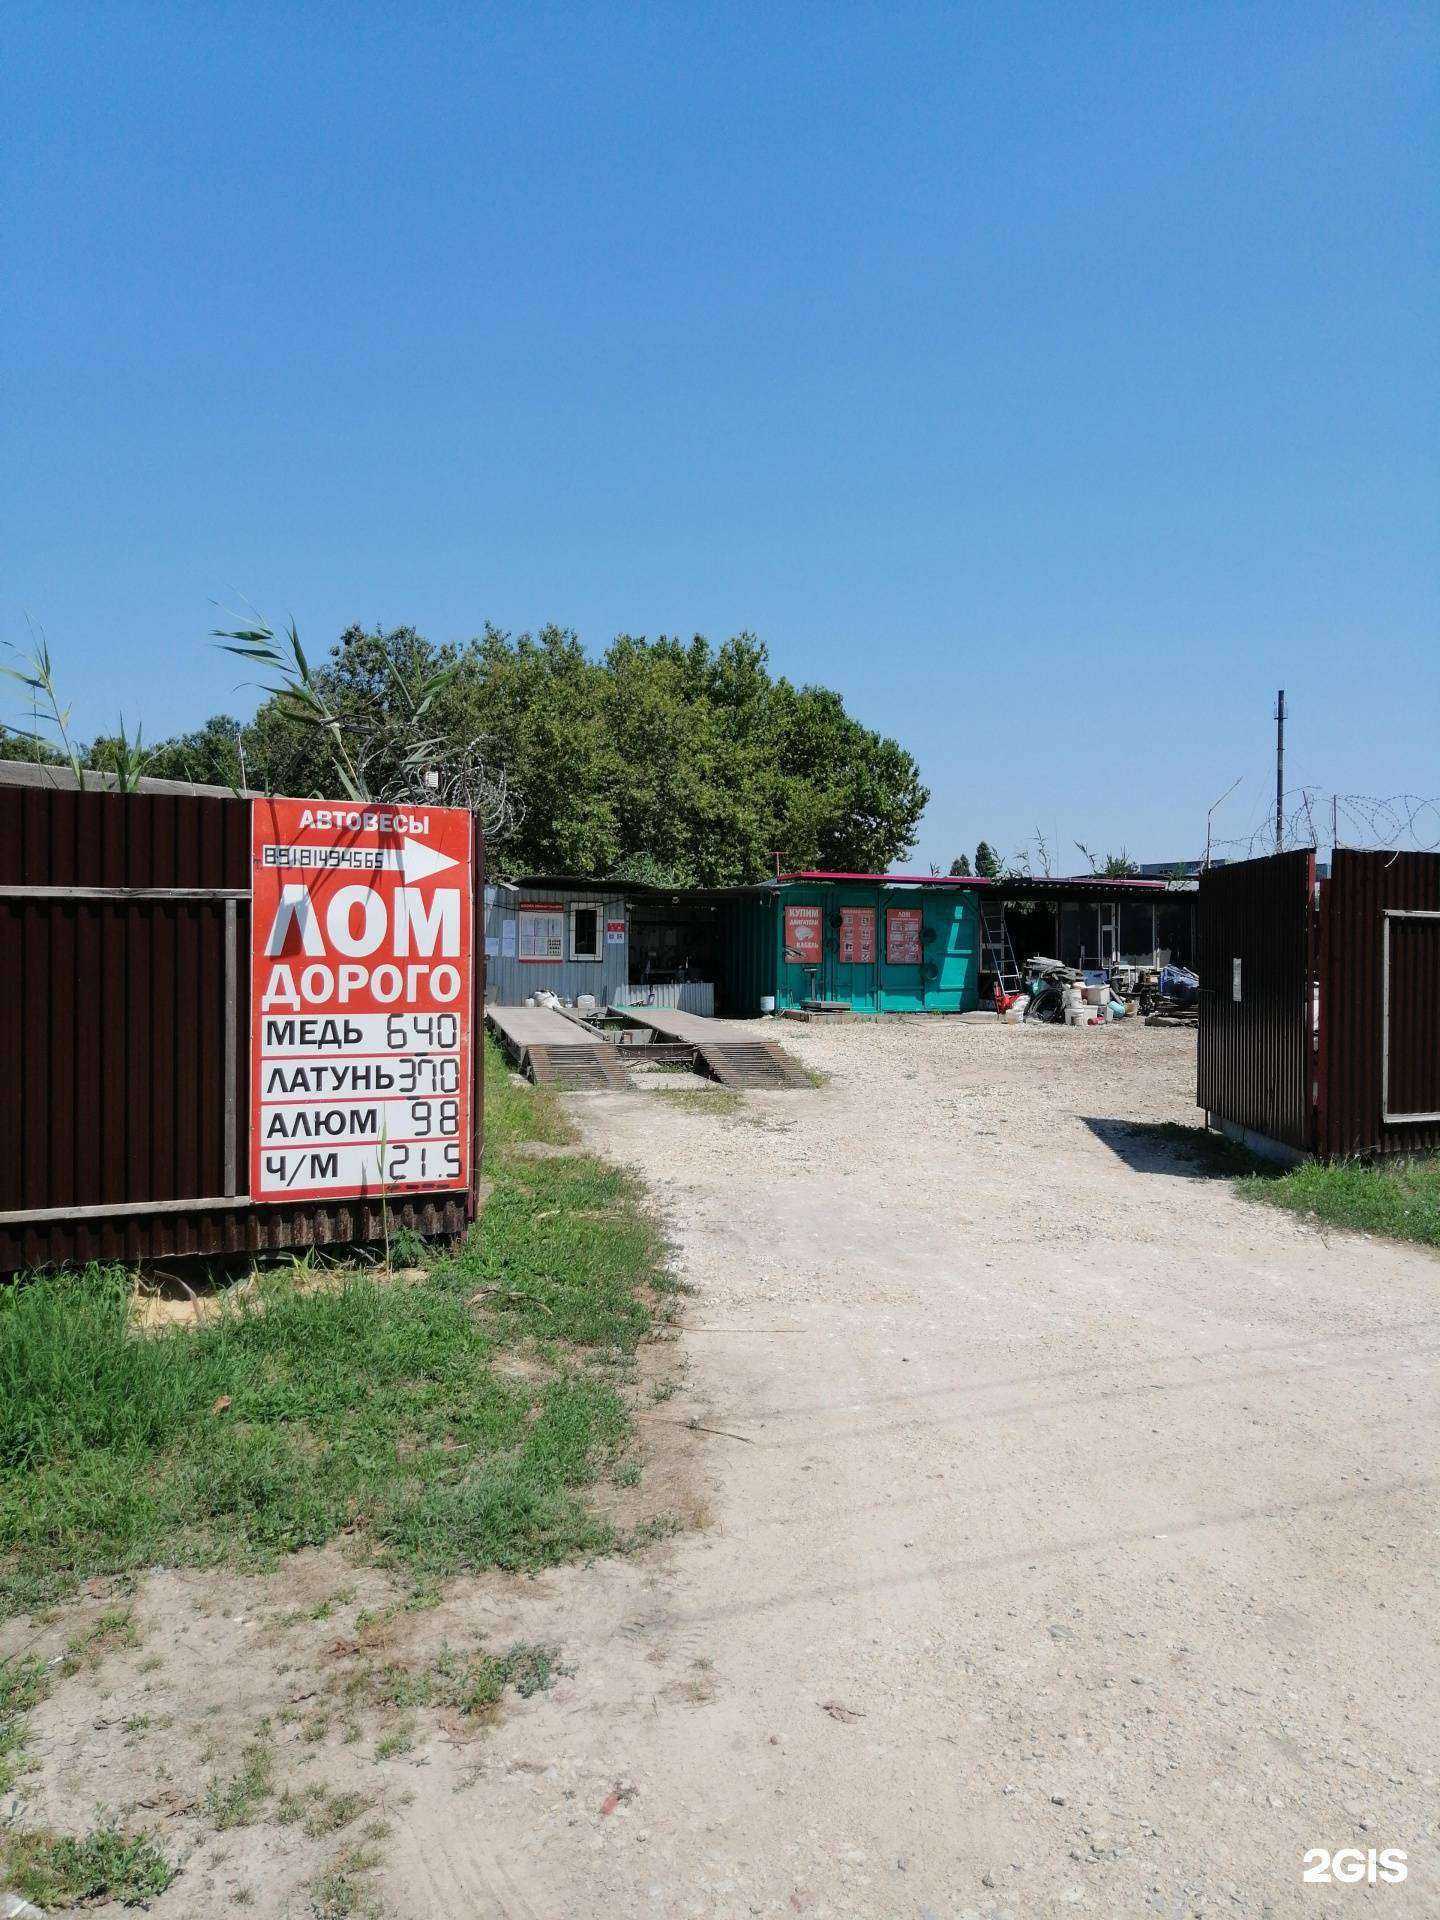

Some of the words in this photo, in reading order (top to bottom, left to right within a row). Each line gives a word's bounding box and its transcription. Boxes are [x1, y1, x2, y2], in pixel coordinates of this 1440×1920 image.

[299, 810, 429, 834] АВТОВЕСЫ
[264, 847, 383, 869] 89181494565
[264, 884, 460, 957] ЛОМ
[262, 964, 461, 1012] ДОРОГО
[266, 1019, 363, 1050] МЕДЬ
[386, 1013, 457, 1049] 640
[266, 1064, 395, 1093] ЛАТУНЬ
[399, 1058, 460, 1093] 370
[266, 1108, 377, 1139] АЛЮМ
[411, 1101, 460, 1136] 98
[266, 1153, 338, 1187] Ч/М
[389, 1144, 461, 1180] 21.5
